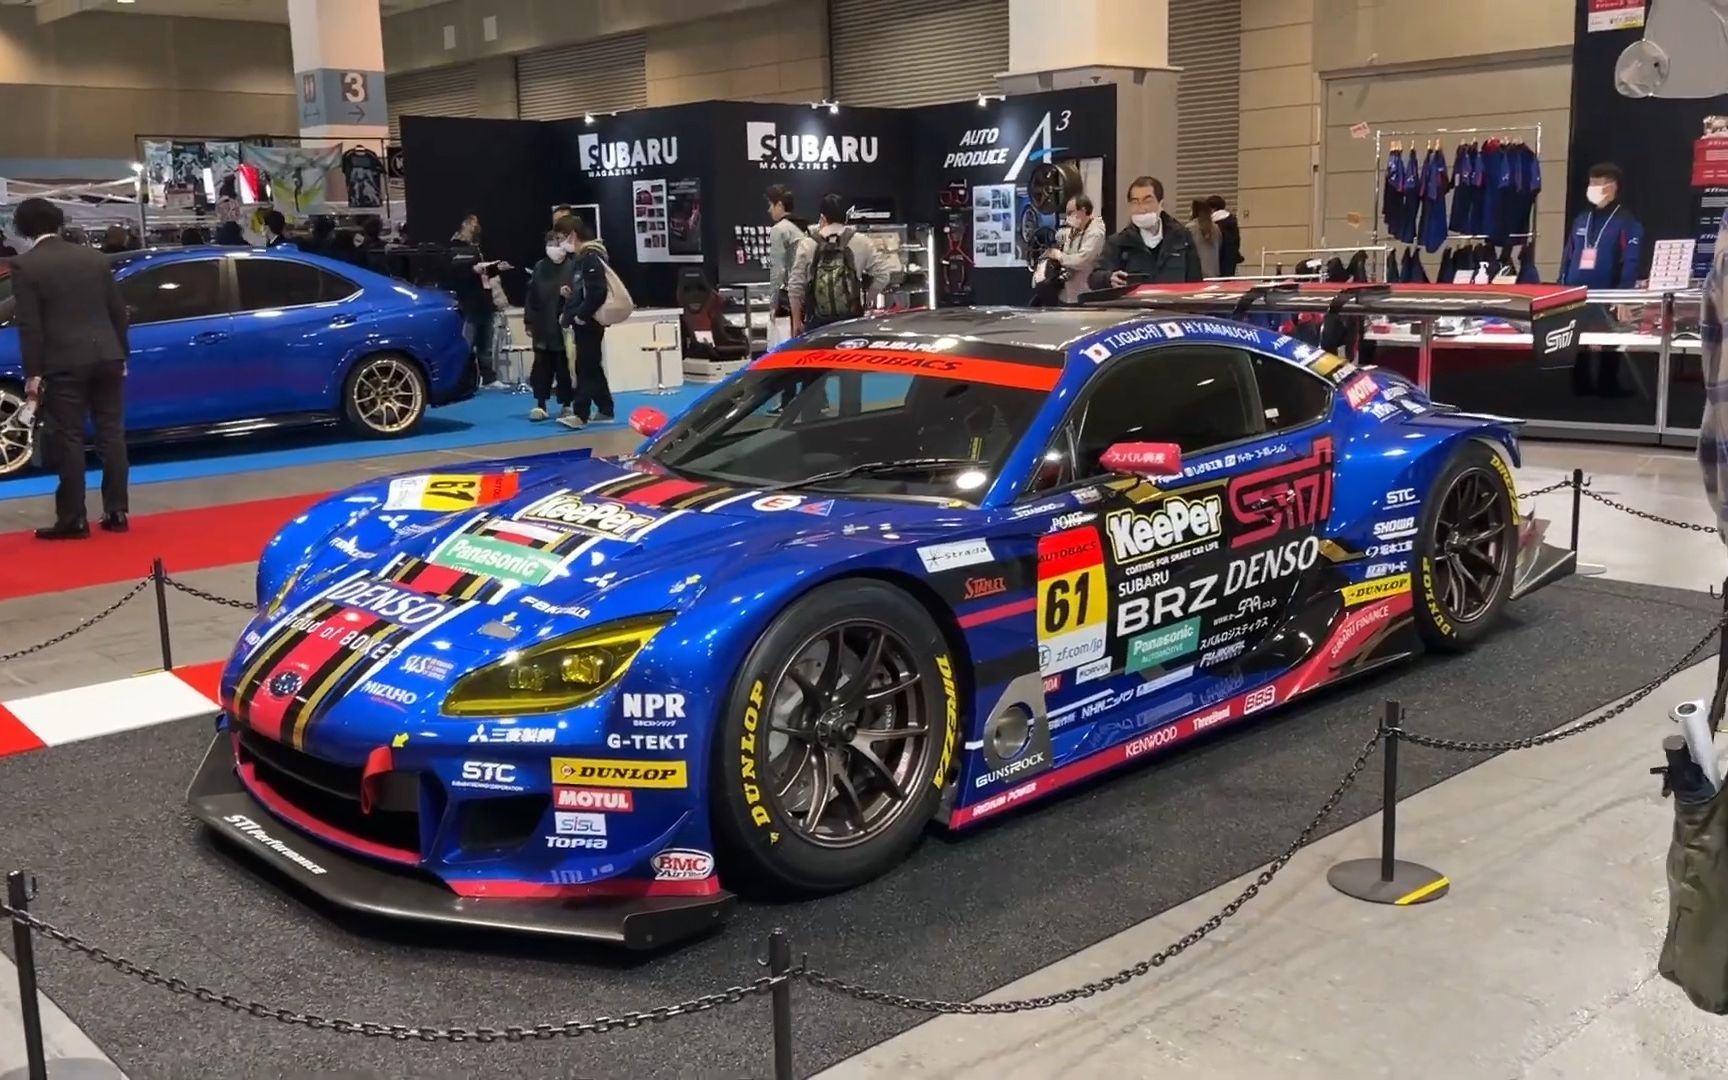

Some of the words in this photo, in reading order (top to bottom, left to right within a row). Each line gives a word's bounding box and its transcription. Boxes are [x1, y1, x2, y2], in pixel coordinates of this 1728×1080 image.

[344, 72, 366, 102] 3
[759, 134, 878, 163] SUBARU
[960, 128, 999, 146] AUTO
[587, 136, 678, 170] SUBARU
[944, 148, 1009, 168] PRODUCE
[820, 353, 963, 371] AUTOBACS
[425, 481, 476, 500] 61
[1386, 488, 1416, 504] STC
[526, 496, 652, 533] KeePer
[1373, 517, 1415, 535] SHOWA
[1109, 498, 1220, 560] KeePer
[447, 540, 538, 577] Panasonic
[1039, 542, 1096, 562] AUTOBACS
[1156, 557, 1169, 568] FOR
[1192, 547, 1204, 557] CAR
[1205, 541, 1219, 552] LIFE
[1223, 536, 1320, 597] DENSO
[1118, 570, 1169, 598] SUBARU
[1356, 578, 1408, 598] DUNLOP
[326, 581, 446, 624] DENSO
[1045, 572, 1089, 633] 61
[1116, 574, 1219, 637] BRZ
[285, 613, 321, 633] Proud
[320, 627, 342, 640] of
[339, 631, 402, 664] BOXER
[1133, 625, 1194, 655] Panasonic
[1200, 616, 1268, 651] スバルロジスティクス
[1331, 623, 1356, 658] SUBARU
[1355, 605, 1389, 633] FINANCE
[1056, 638, 1102, 662] zf.com/jp
[1080, 663, 1109, 677] FORVIA
[360, 680, 417, 704] MIZUHO
[623, 693, 686, 718] NPR
[1245, 686, 1275, 714] BBS
[607, 733, 688, 749] G-TEKT
[741, 680, 771, 826] DUNLOP
[1125, 726, 1178, 758] KENWOOD
[462, 761, 516, 782] STC
[580, 766, 677, 780] DUNLOP
[976, 752, 1044, 788] GUNSROCK
[558, 790, 629, 808] MOTUL
[1007, 782, 1036, 802] POWER
[660, 856, 707, 871] BMC
